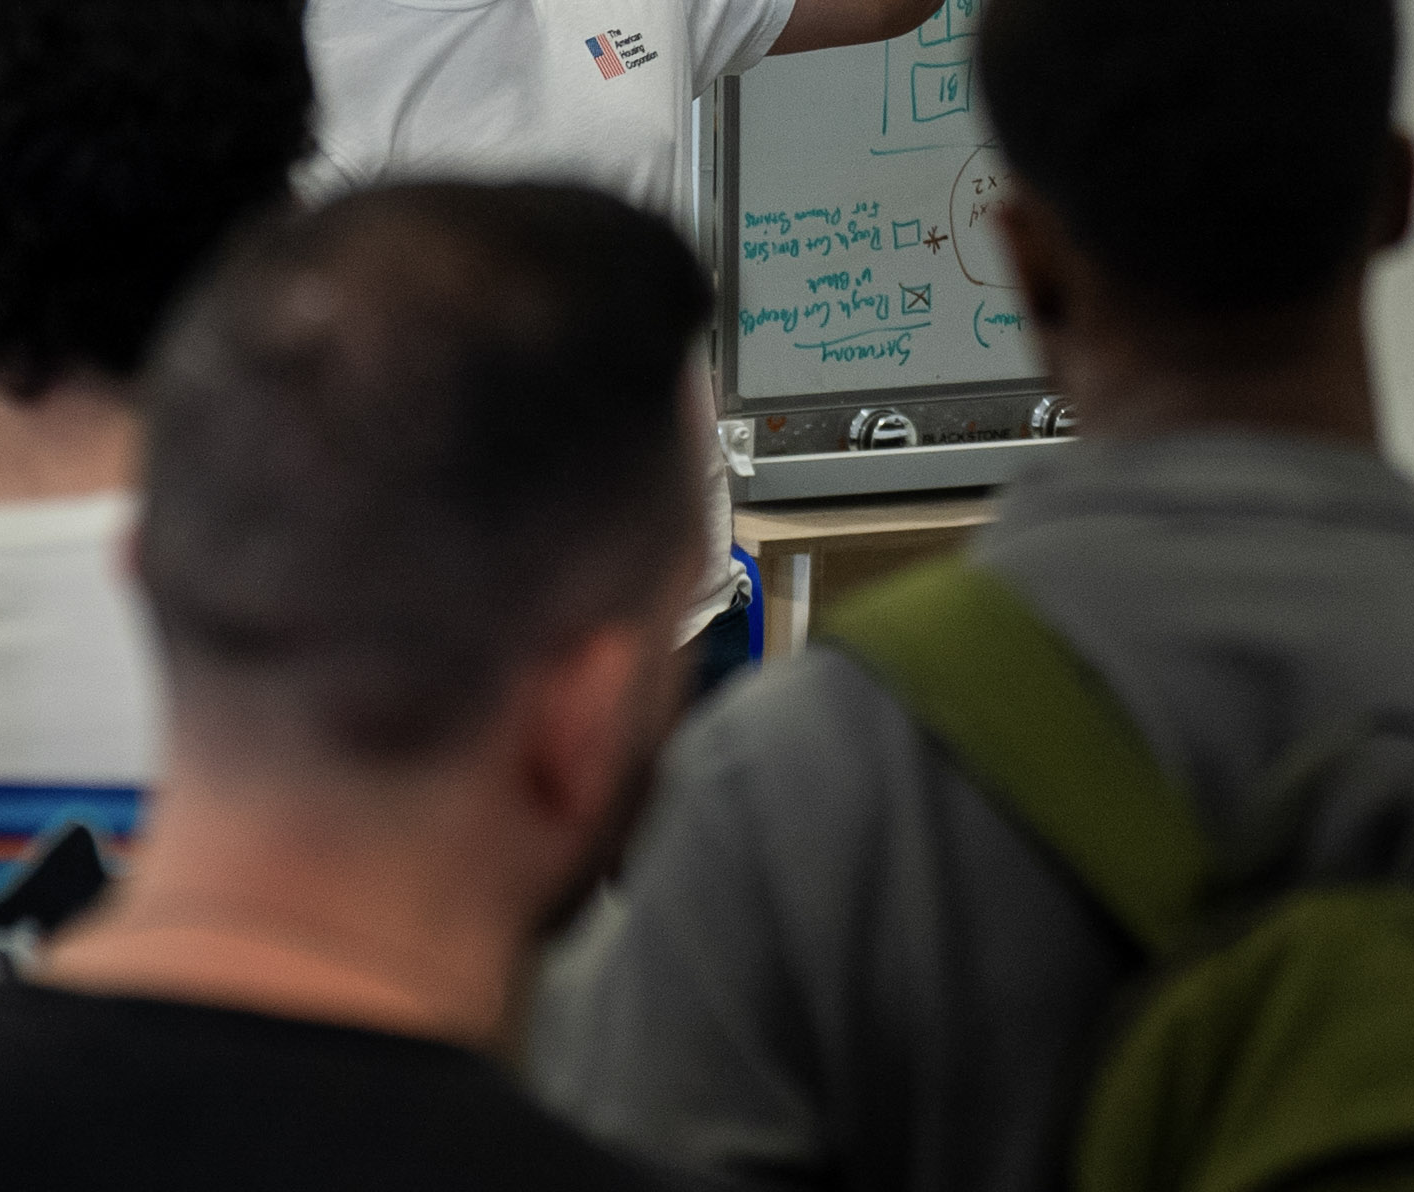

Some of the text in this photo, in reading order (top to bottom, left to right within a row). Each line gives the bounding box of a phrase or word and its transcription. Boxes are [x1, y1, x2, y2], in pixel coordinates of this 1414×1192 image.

[607, 29, 622, 39] The
[615, 32, 643, 49] American
[619, 43, 645, 59] Housing
[625, 50, 658, 69] Corporation
[922, 427, 1012, 445] BLACKSTONE
